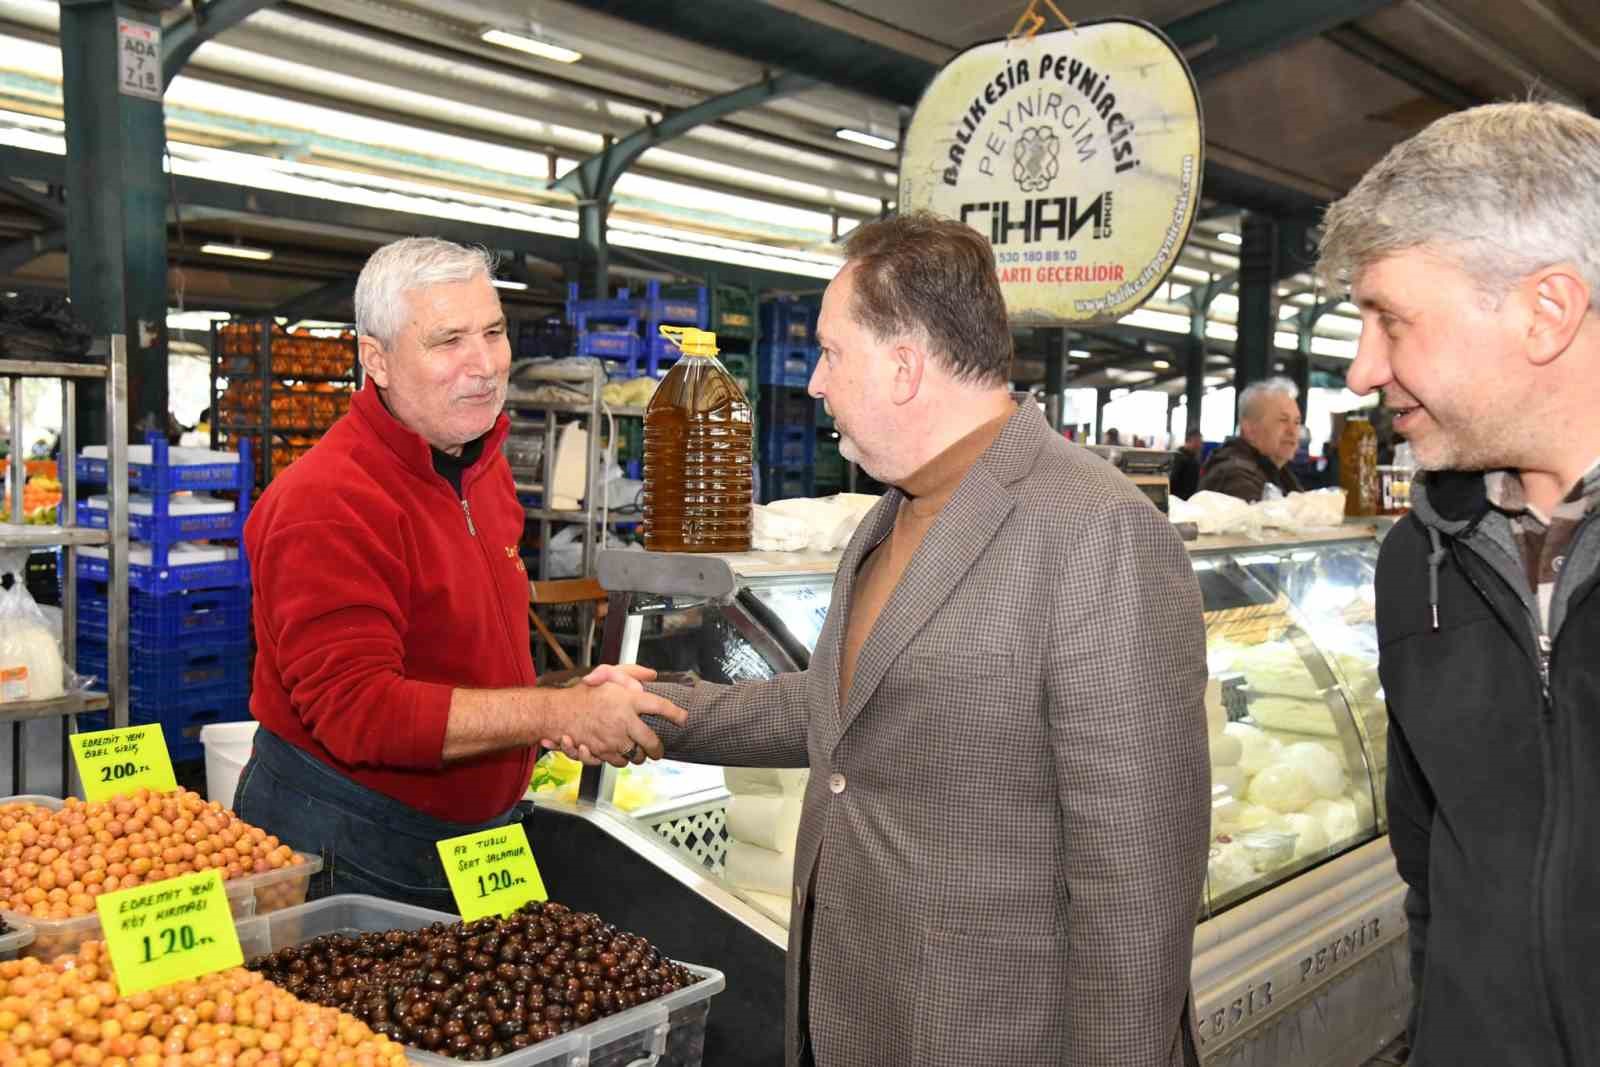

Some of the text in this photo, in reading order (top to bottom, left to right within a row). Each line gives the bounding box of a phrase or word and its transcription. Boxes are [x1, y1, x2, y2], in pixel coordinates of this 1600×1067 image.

[125, 39, 156, 58] ADA
[136, 57, 144, 70] 7
[1039, 53, 1140, 174] PEYNİRCİSİ
[978, 88, 1097, 177] PEYNİRCİM
[999, 250, 1077, 264] 530 180 88 10
[995, 266, 1031, 283] ARTI
[1299, 917, 1380, 982] PEYNİR
